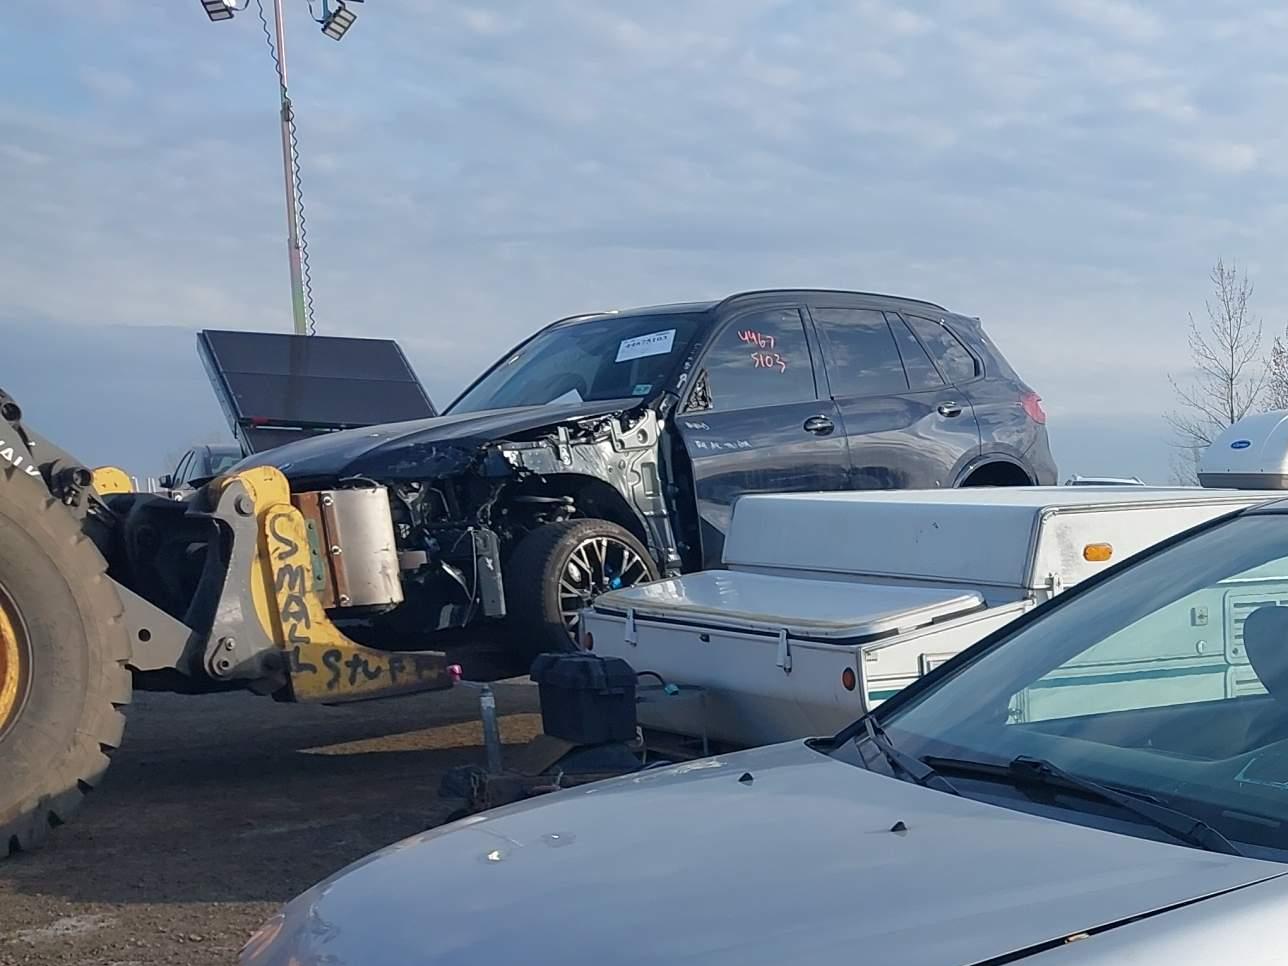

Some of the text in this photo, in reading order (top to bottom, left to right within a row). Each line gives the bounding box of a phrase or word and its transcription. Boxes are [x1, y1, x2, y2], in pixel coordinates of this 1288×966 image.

[737, 330, 775, 349] 4467
[751, 351, 786, 374] 5103
[269, 512, 318, 676] SMALL
